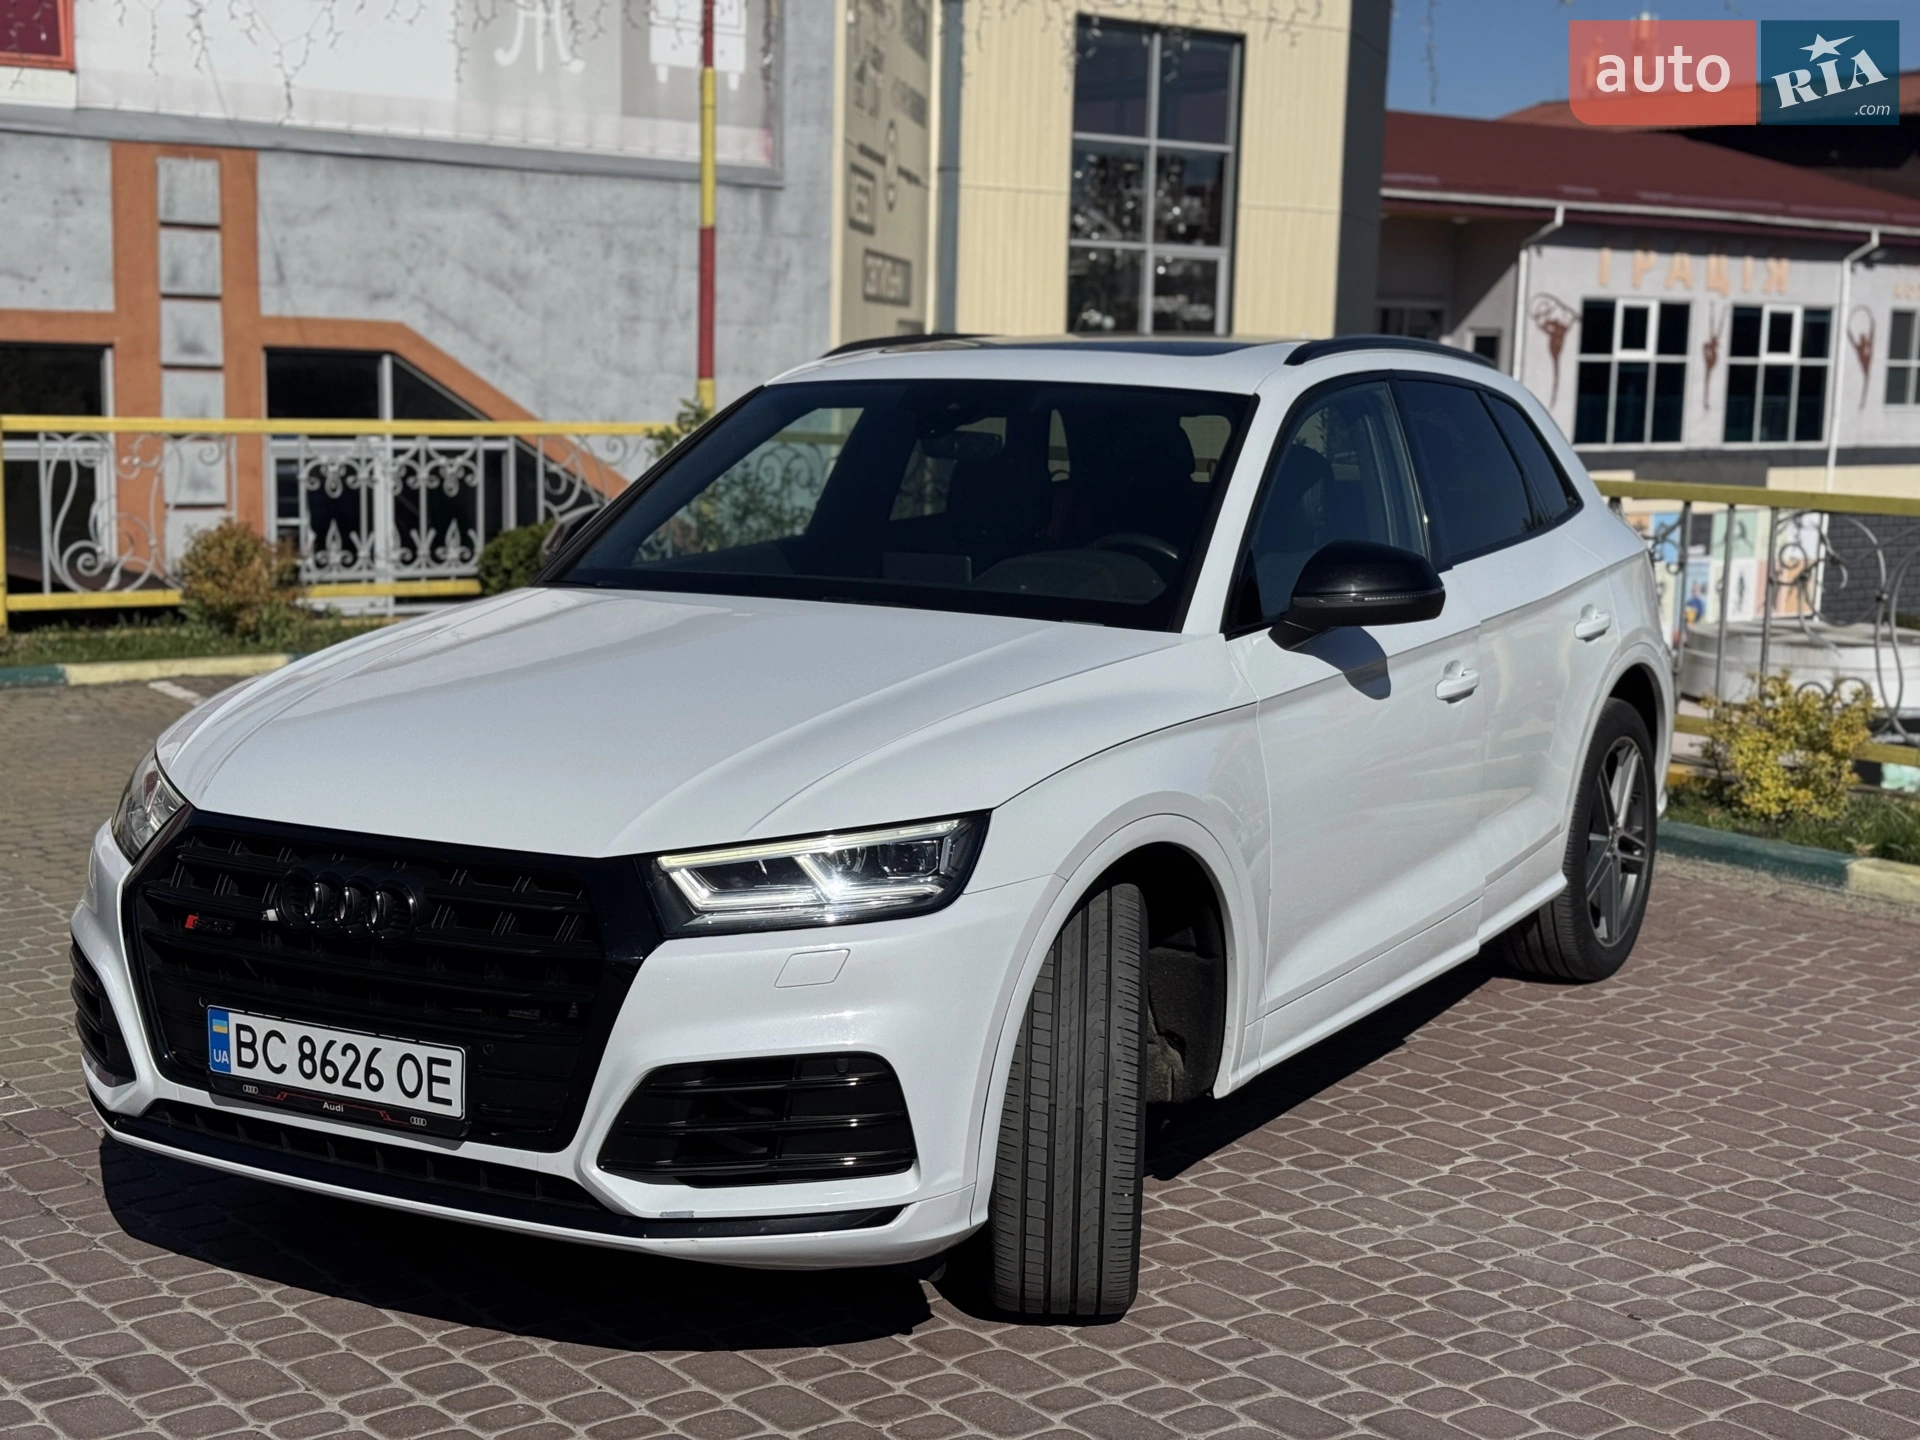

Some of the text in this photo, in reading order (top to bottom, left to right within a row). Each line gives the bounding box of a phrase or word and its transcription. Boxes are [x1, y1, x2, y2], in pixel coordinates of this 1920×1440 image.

[213, 1048, 230, 1065] UA
[235, 1023, 454, 1107] BC 8626 OE
[322, 1100, 344, 1113] Audi
